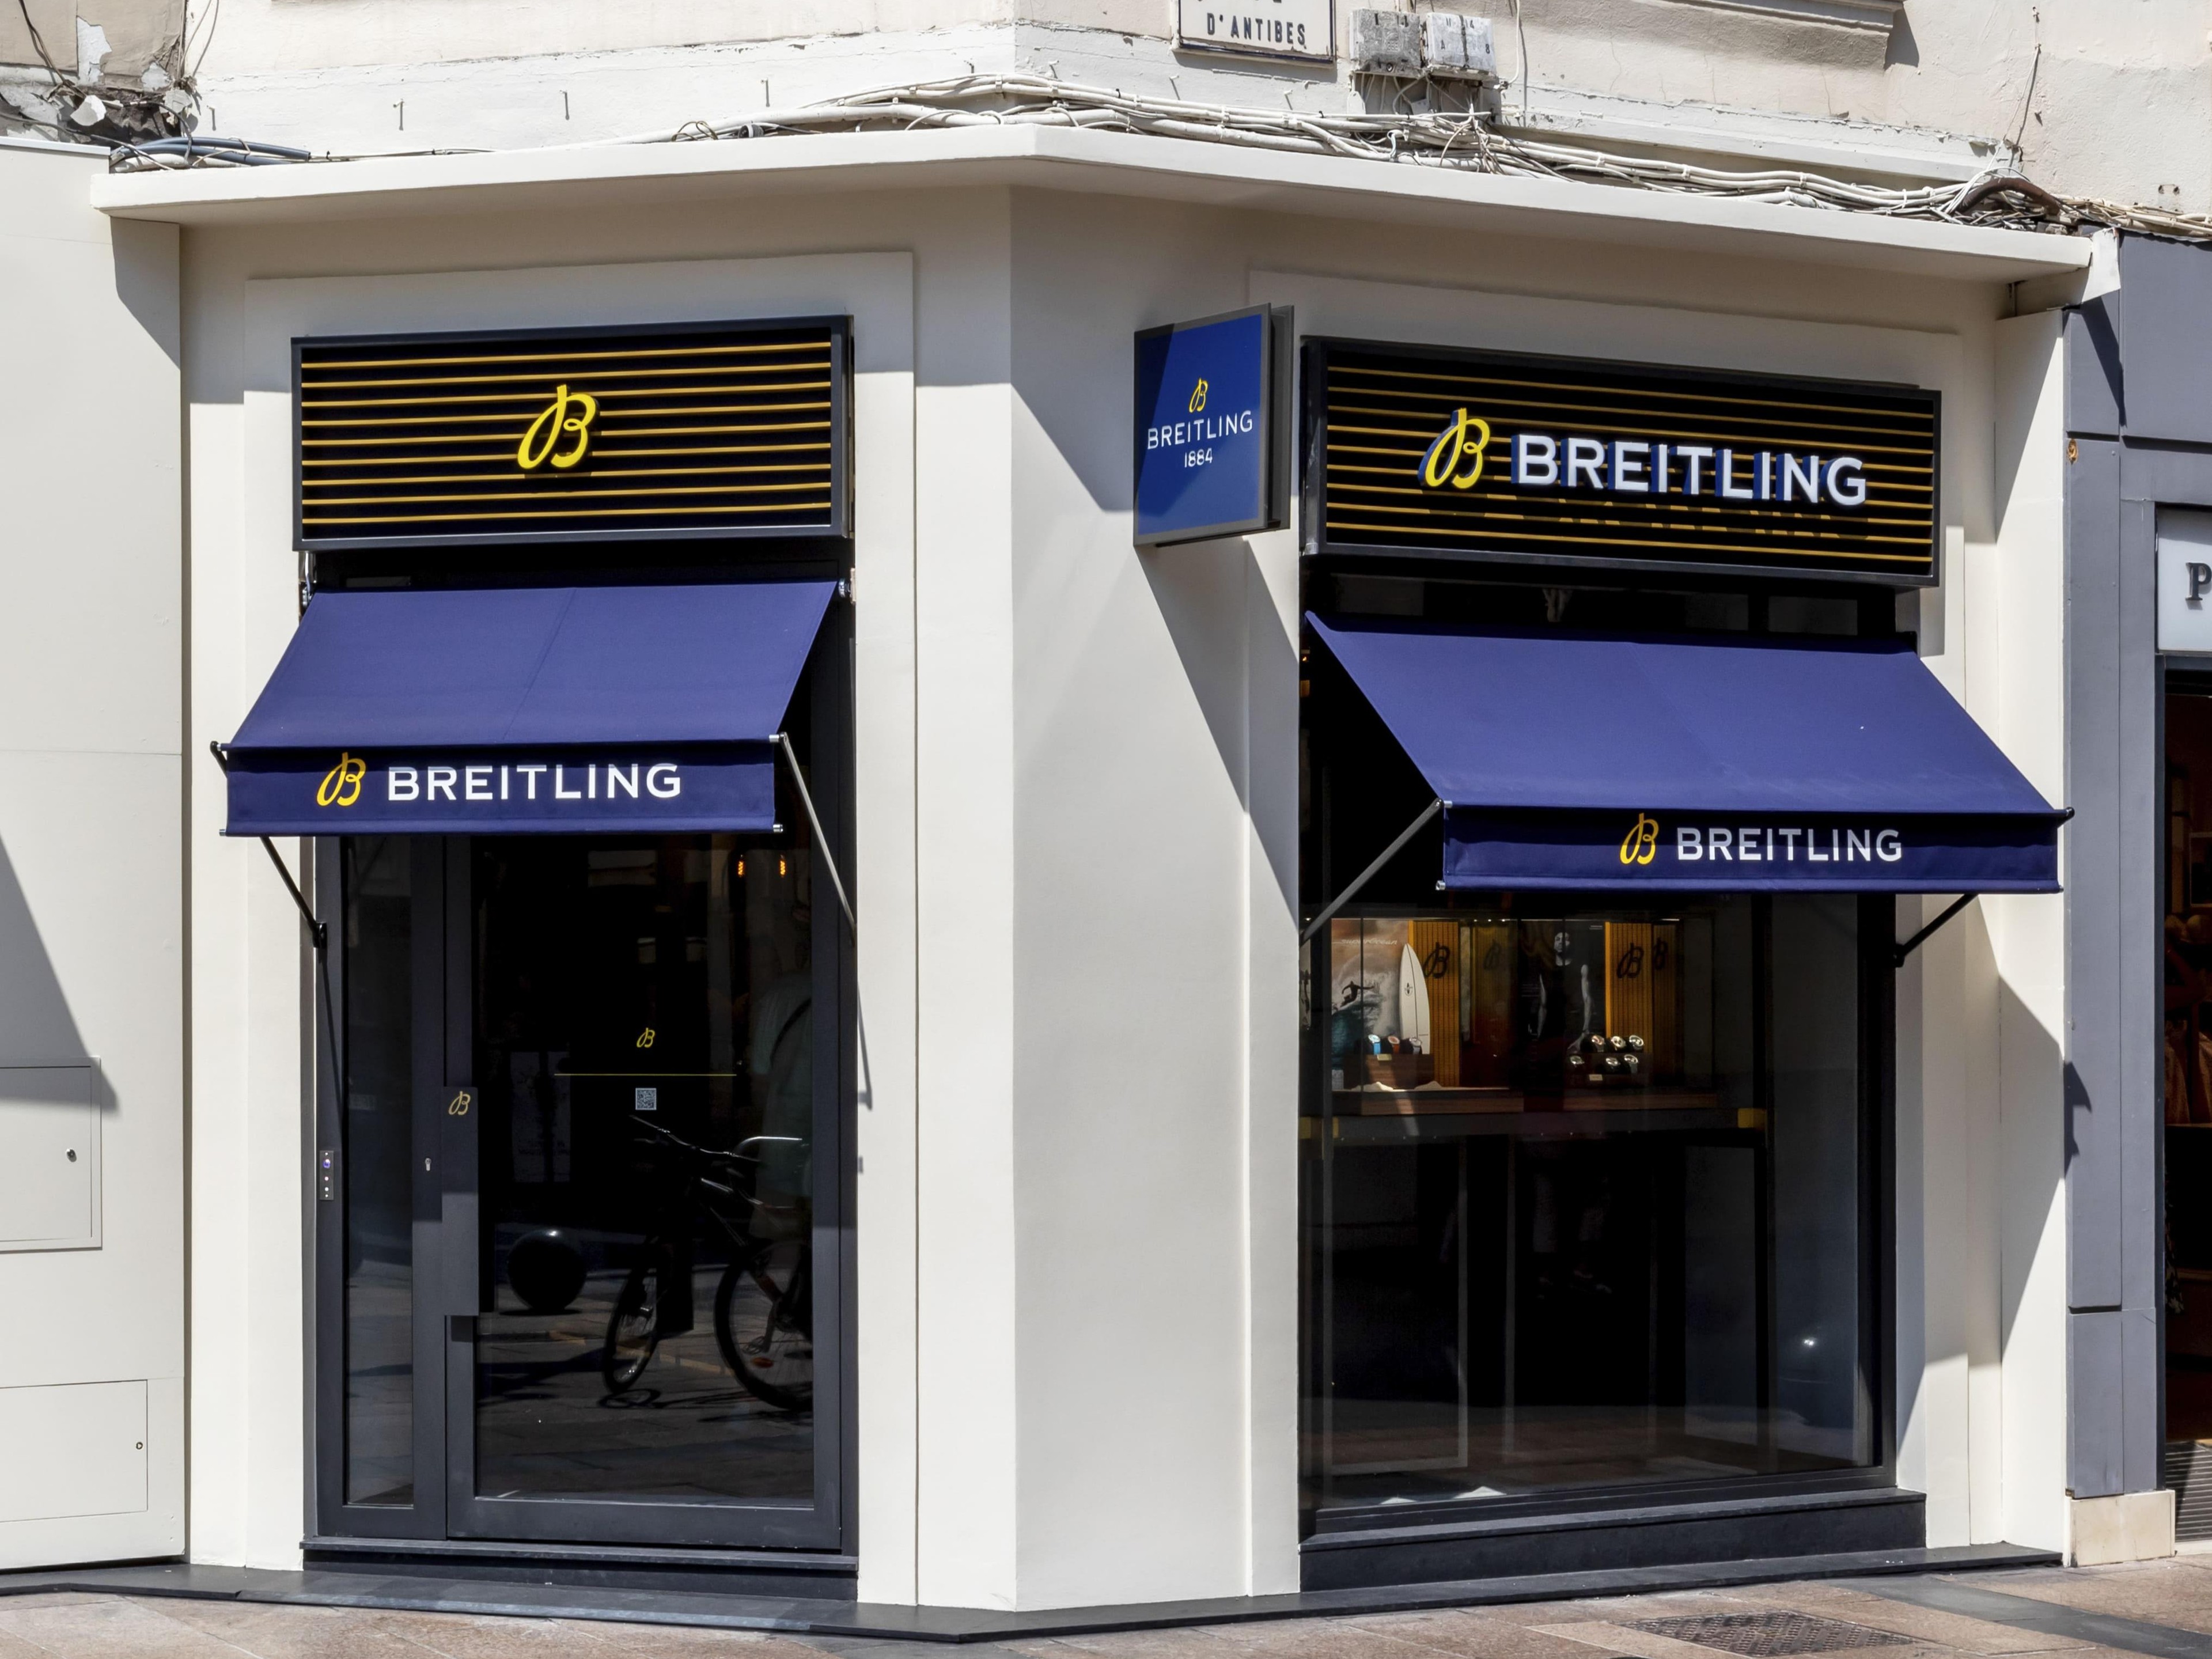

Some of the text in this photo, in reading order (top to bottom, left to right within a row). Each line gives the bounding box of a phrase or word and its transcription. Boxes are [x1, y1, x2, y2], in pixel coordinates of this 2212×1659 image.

[1207, 13, 1306, 46] D'ANTIBES
[1147, 410, 1253, 450] BREITLING
[1184, 447, 1213, 468] 1884
[1512, 434, 1866, 506] BREITLING
[387, 763, 682, 802] BREITLING
[1676, 828, 1903, 863] BREITLING
